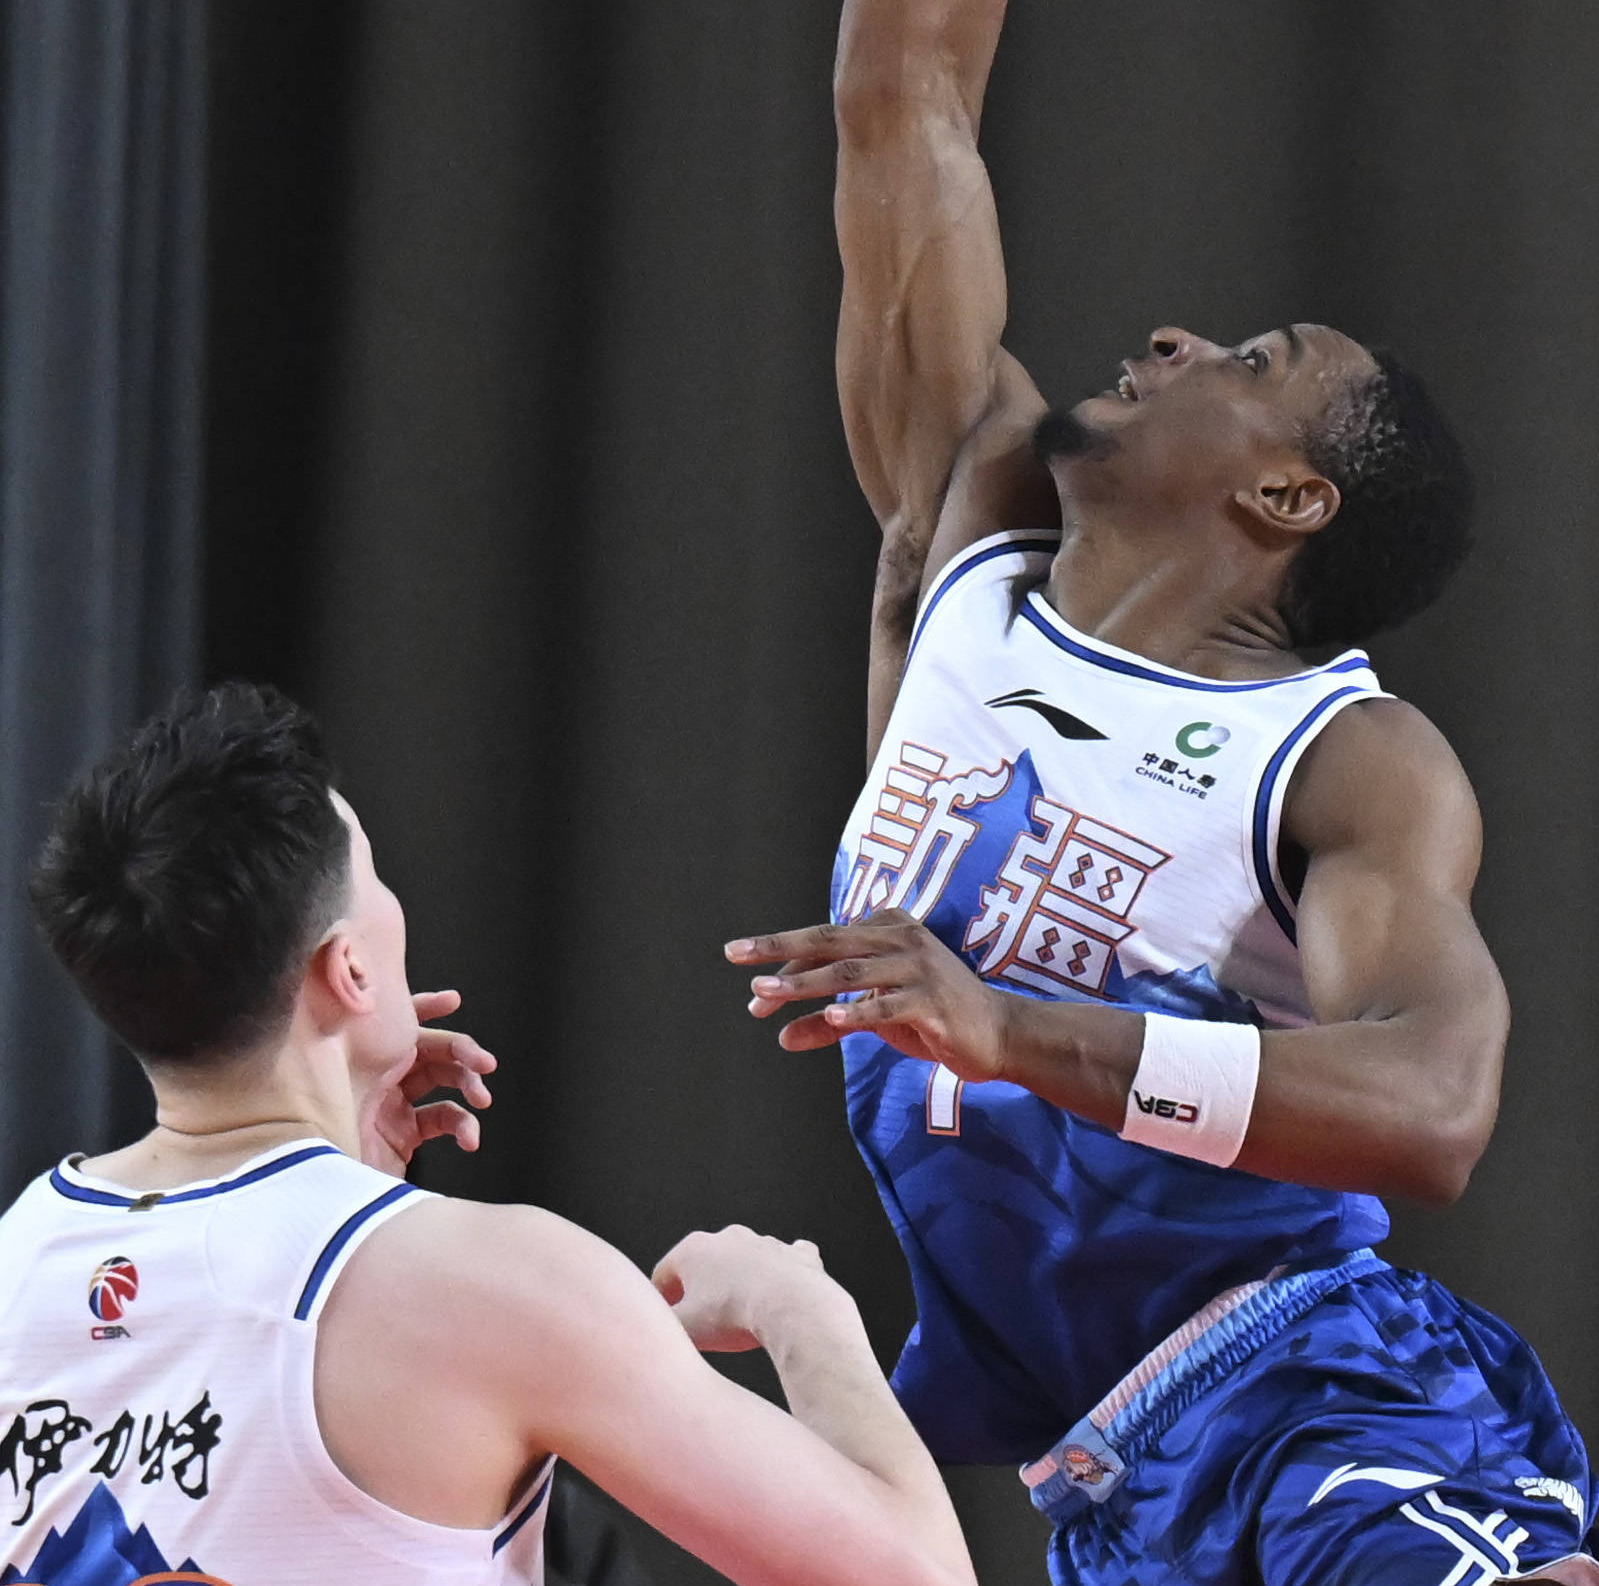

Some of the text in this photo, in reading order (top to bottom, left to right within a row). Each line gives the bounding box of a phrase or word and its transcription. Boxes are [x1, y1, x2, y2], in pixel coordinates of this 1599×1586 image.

[1135, 766, 1208, 800] CHINA LIFE
[1142, 752, 1217, 789] 中国人寿
[842, 740, 1174, 1004] 新疆
[91, 1325, 131, 1341] CBA
